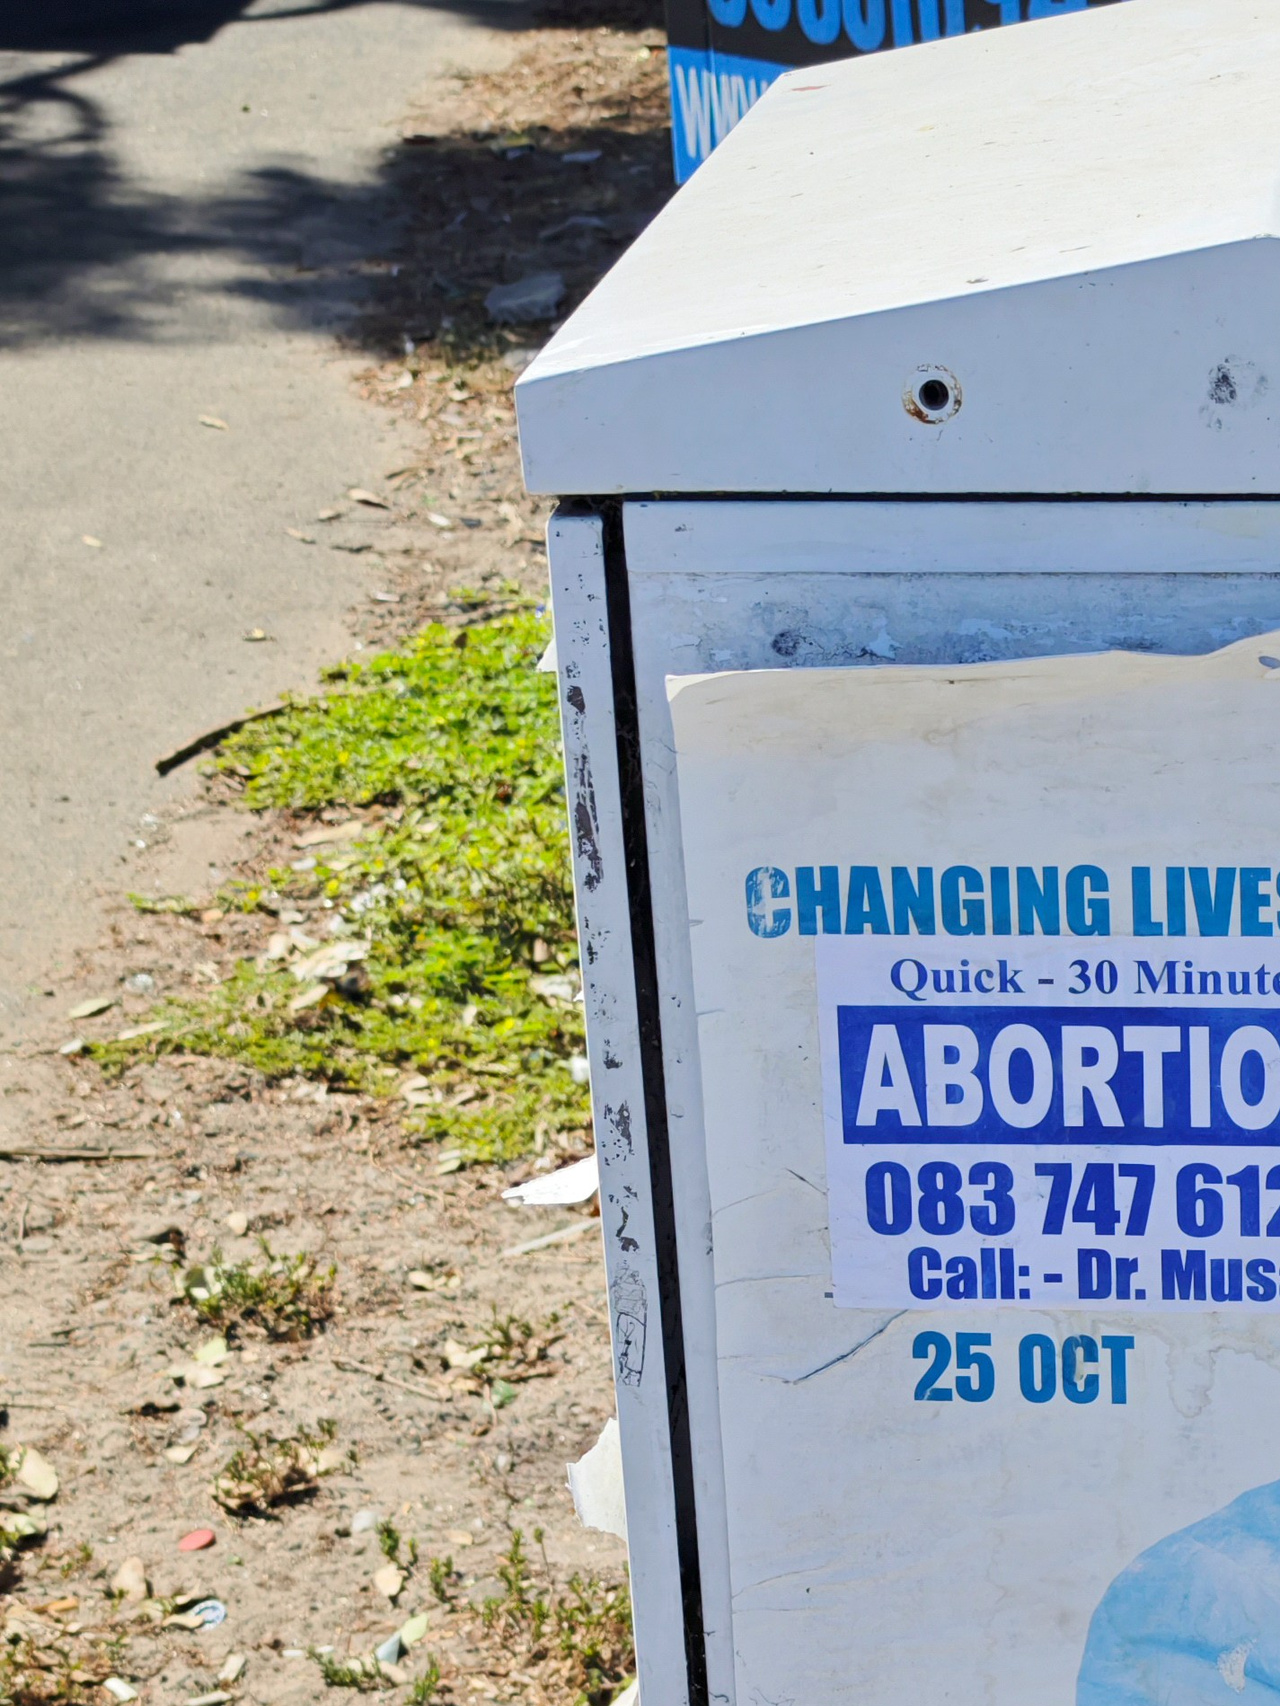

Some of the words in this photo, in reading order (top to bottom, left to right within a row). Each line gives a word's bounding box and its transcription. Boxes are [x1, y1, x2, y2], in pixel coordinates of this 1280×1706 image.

[745, 865, 1110, 938] CHANGING
[890, 958, 1025, 1001] Quick
[1069, 959, 1118, 995] 30
[865, 1161, 1015, 1237] 083
[1034, 1162, 1156, 1237] 747
[907, 1246, 1031, 1301] Call:
[1077, 1248, 1147, 1301] Dr.
[912, 1331, 995, 1403] 25
[1018, 1333, 1135, 1405] OCT
